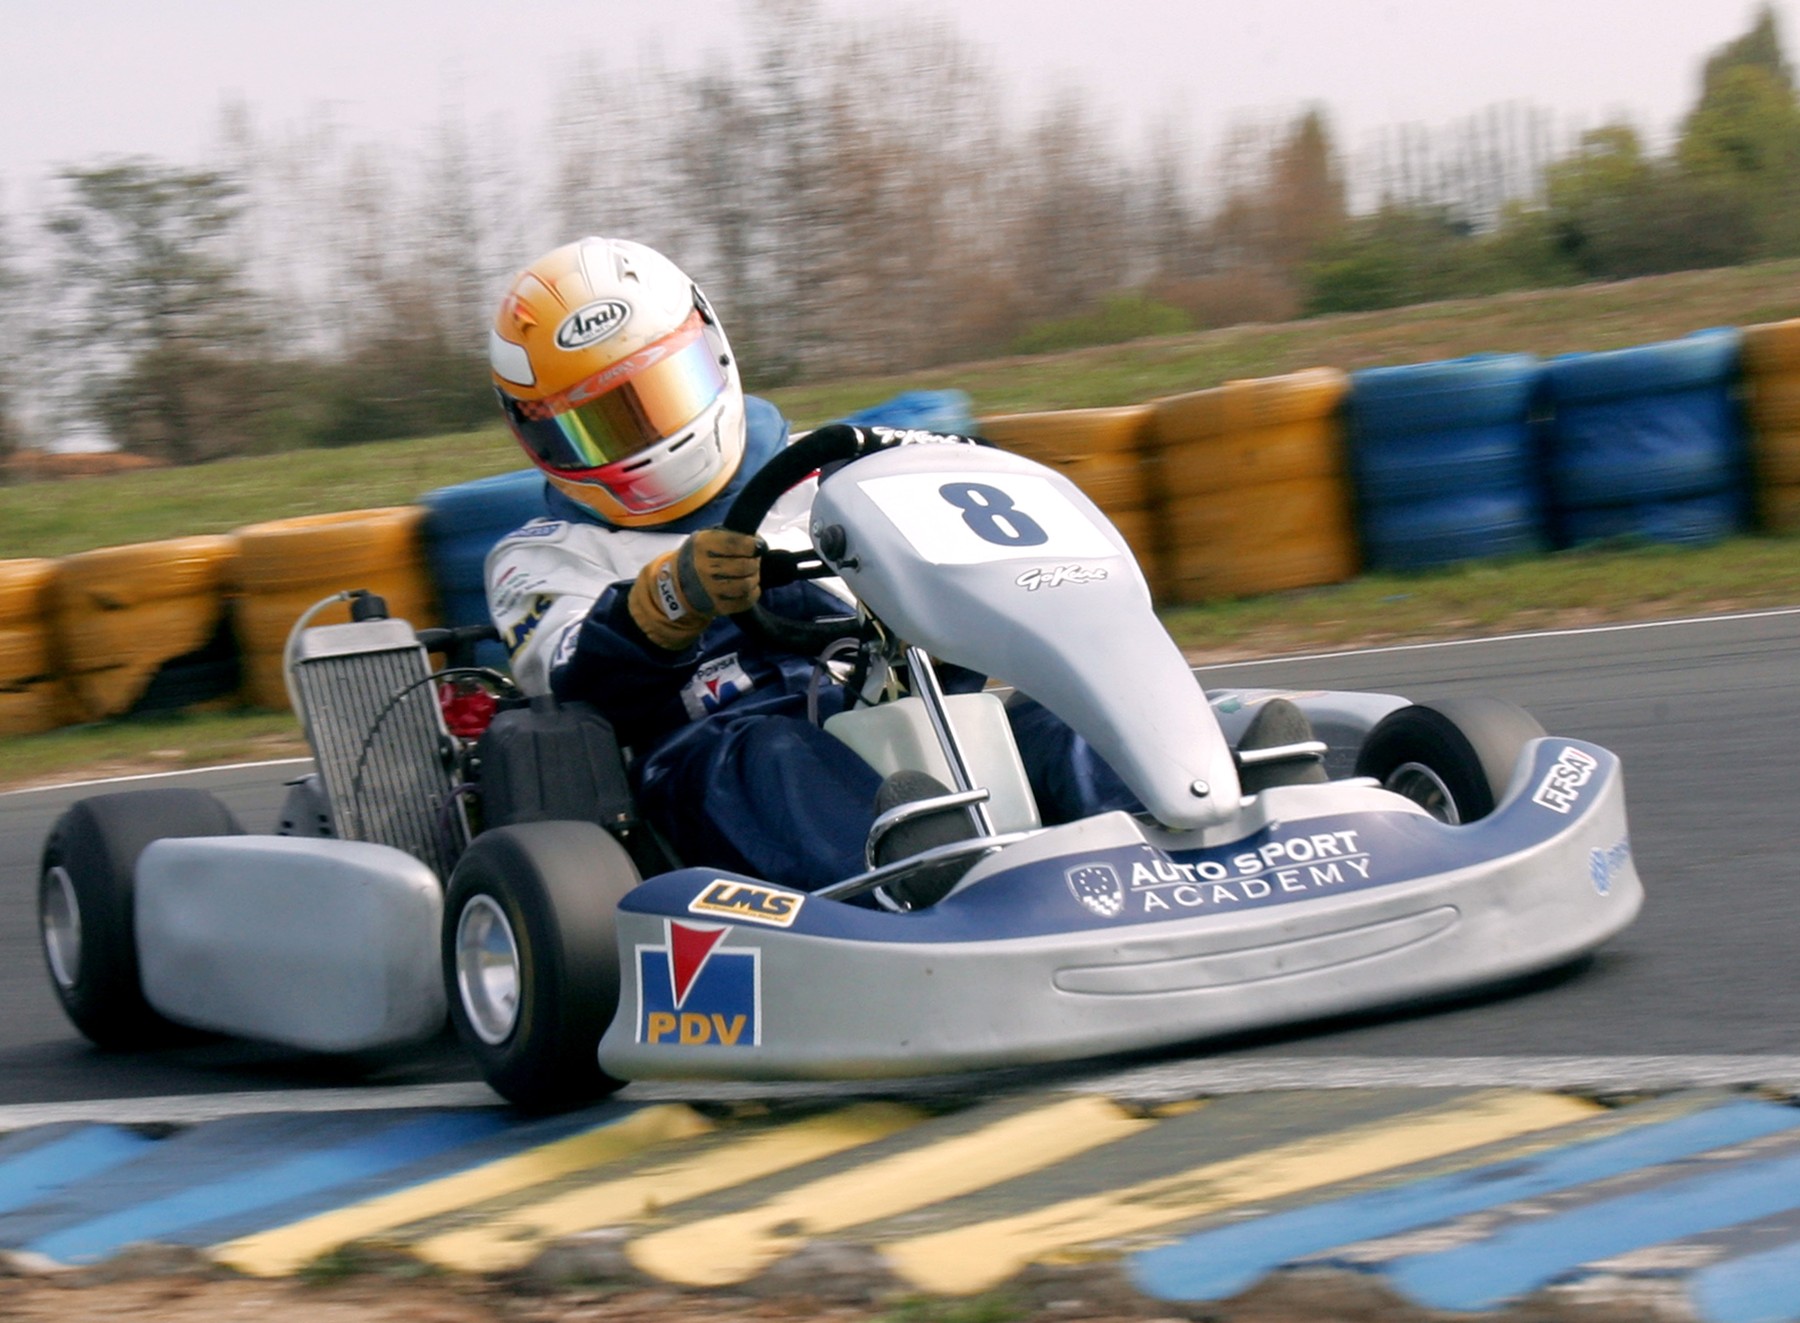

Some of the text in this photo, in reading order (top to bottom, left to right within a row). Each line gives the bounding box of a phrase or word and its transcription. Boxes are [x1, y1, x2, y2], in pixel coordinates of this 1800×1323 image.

[563, 303, 618, 344] Arai
[938, 482, 1049, 547] 8
[1540, 756, 1591, 810] FFSA
[1131, 830, 1359, 886] AUTO SPORT
[1143, 857, 1371, 913] ACADEMY
[703, 884, 796, 916] LMS
[647, 1011, 747, 1046] PDV
